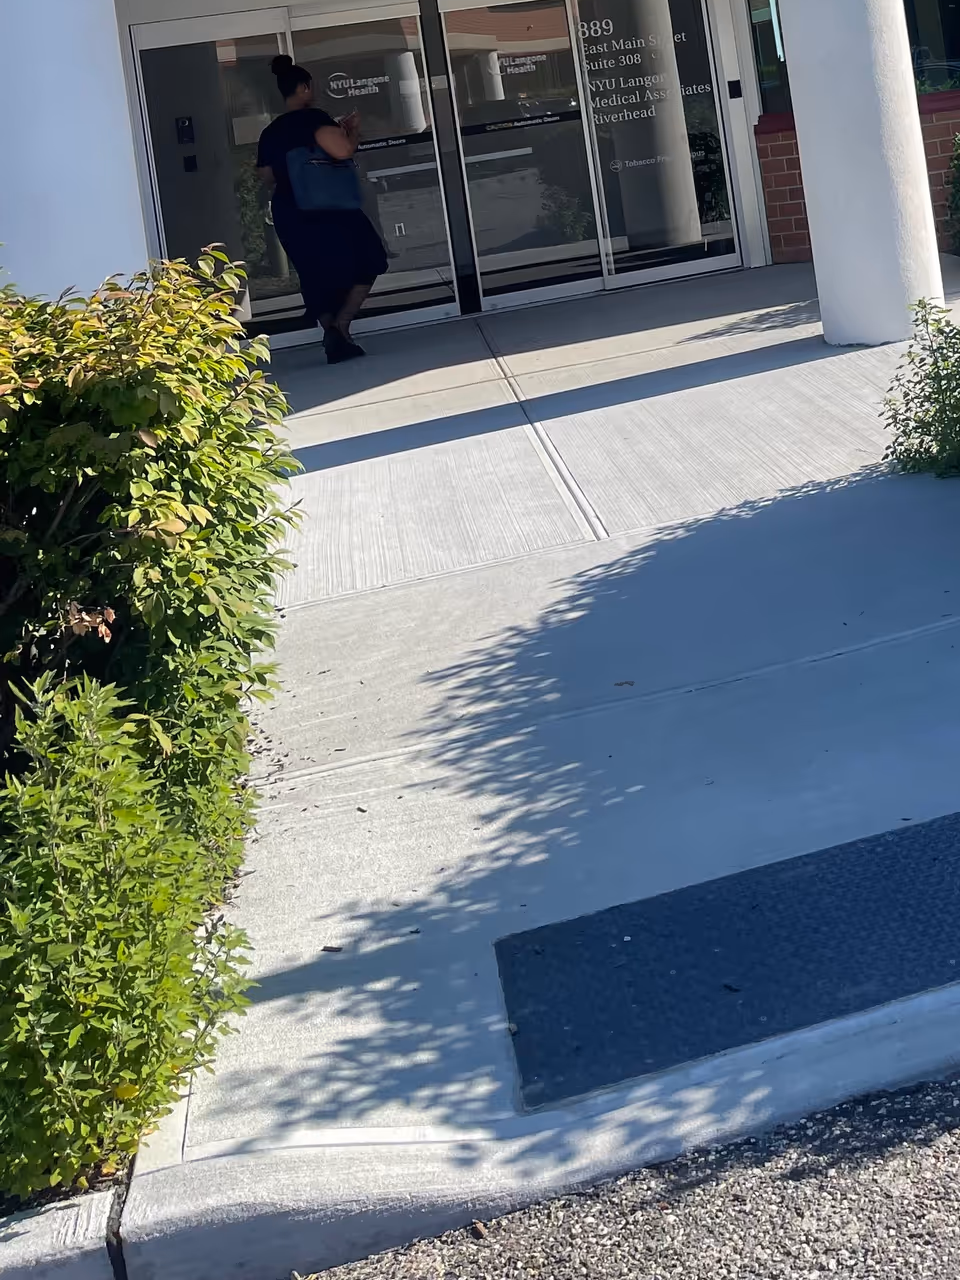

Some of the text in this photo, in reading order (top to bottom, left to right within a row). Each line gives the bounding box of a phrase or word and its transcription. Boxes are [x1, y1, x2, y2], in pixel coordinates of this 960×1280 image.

[577, 18, 614, 39] 889
[580, 43, 609, 56] East
[611, 37, 646, 52] Main
[582, 53, 642, 71] Suite 308
[347, 85, 379, 97] Health
